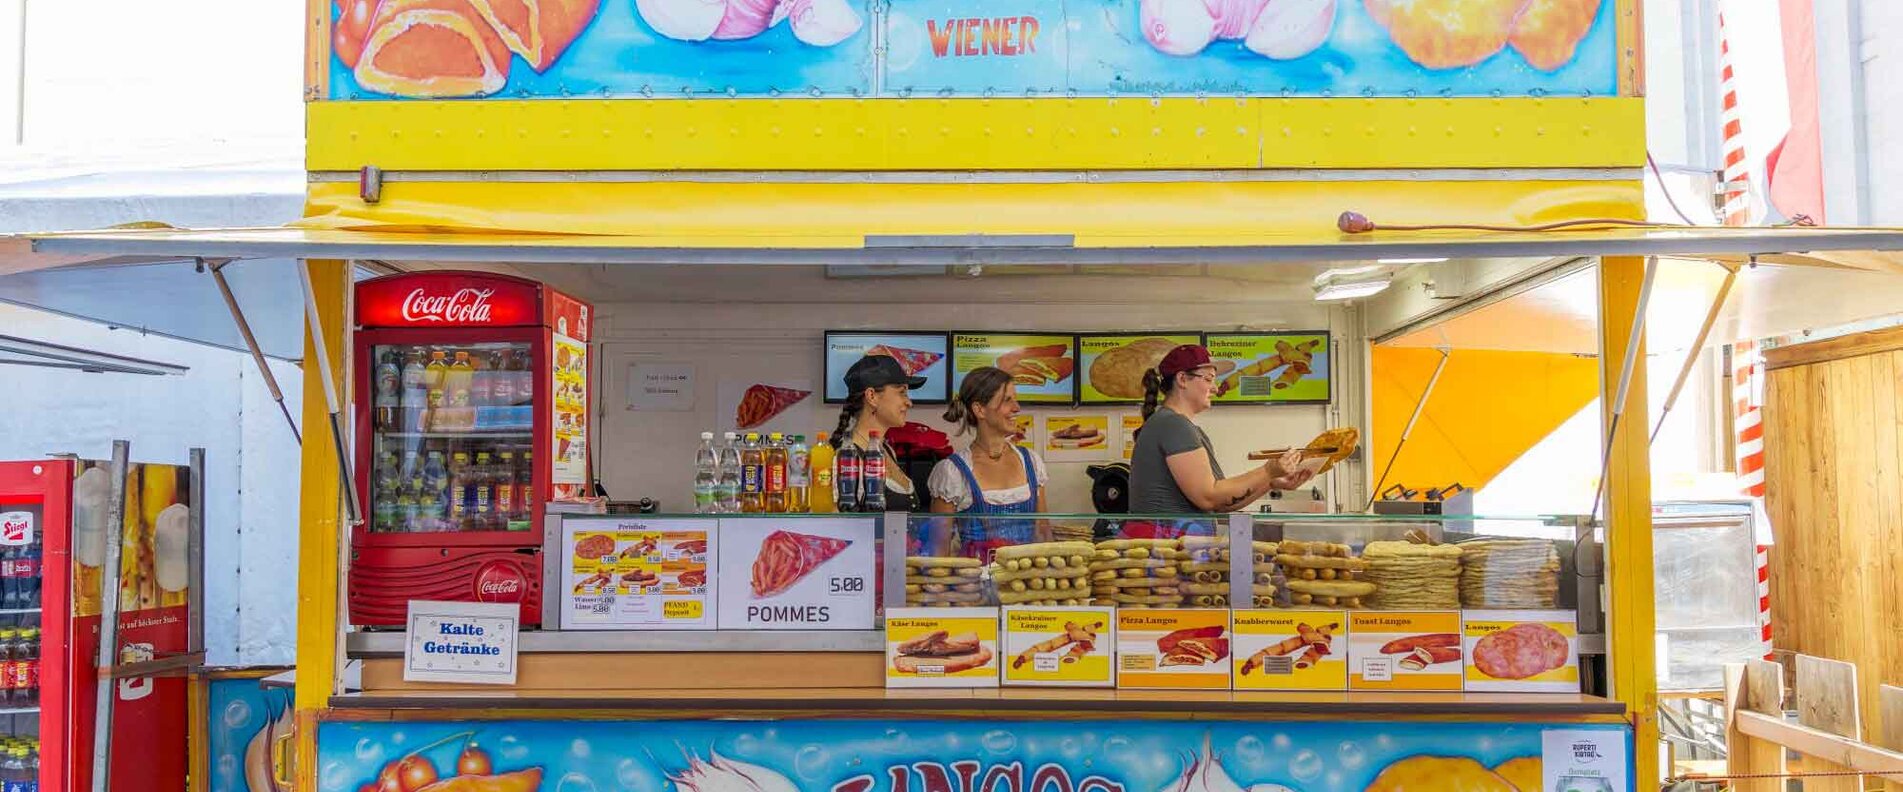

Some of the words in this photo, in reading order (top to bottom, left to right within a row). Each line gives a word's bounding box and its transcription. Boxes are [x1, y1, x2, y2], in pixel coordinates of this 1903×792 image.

[927, 16, 1040, 58] WIENER
[402, 288, 495, 322] Coca-Cola
[957, 335, 987, 343] Pizza
[1211, 350, 1242, 358] Langos
[4, 521, 28, 537] Stiegl
[482, 580, 518, 594] Coca-Cola
[830, 577, 863, 592] 5.00
[664, 601, 689, 609] PFAND
[664, 609, 689, 617] Deposit
[748, 606, 830, 622] POMMES
[1121, 616, 1144, 624] Pizza
[1146, 616, 1178, 625] Langos
[1234, 617, 1293, 625] Knabberwurst
[1380, 618, 1412, 626] Langos
[440, 622, 484, 636] Kalte
[1021, 622, 1048, 630] Langos
[1465, 624, 1501, 632] Langos
[424, 641, 500, 656] Getränke
